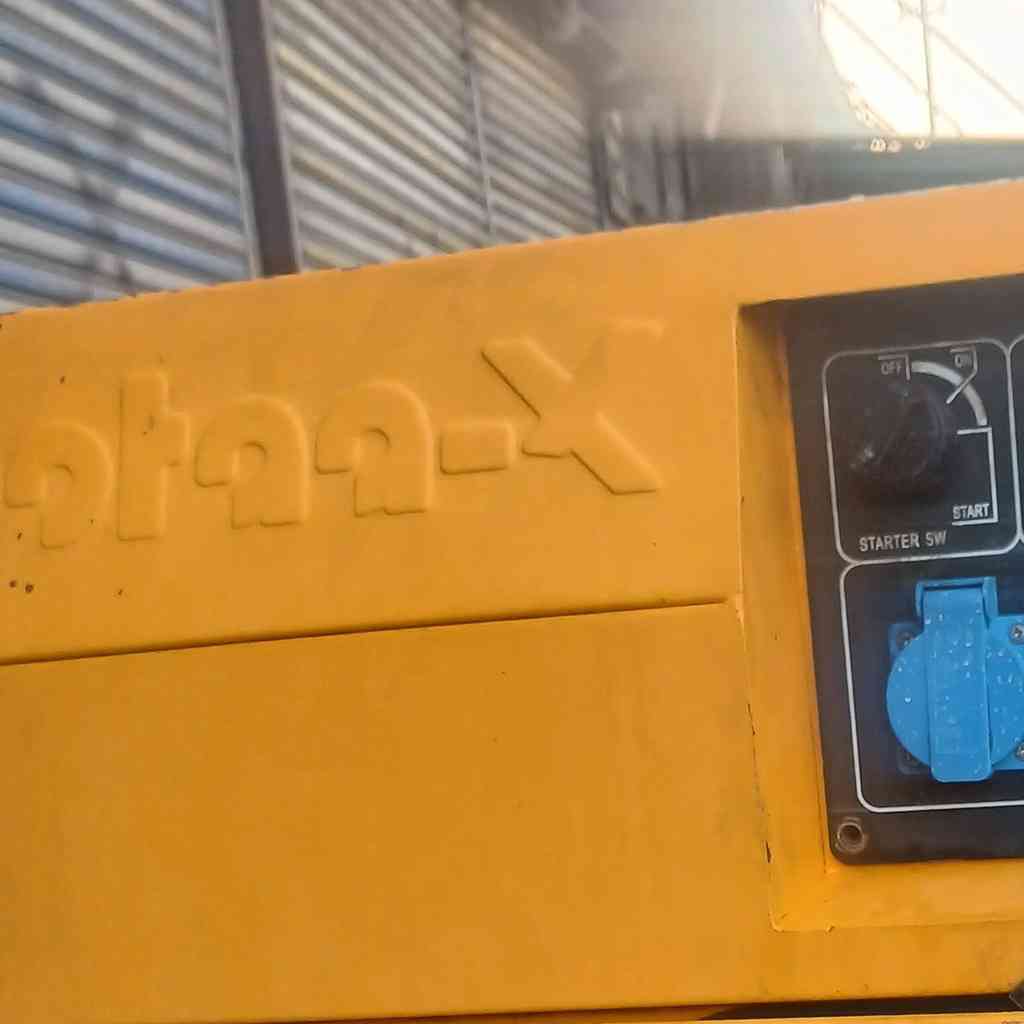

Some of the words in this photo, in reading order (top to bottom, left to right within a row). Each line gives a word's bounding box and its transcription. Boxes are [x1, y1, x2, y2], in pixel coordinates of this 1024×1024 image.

[880, 360, 904, 377] OFF
[952, 504, 990, 521] START
[859, 533, 920, 552] STARTER
[925, 531, 948, 549] SW
